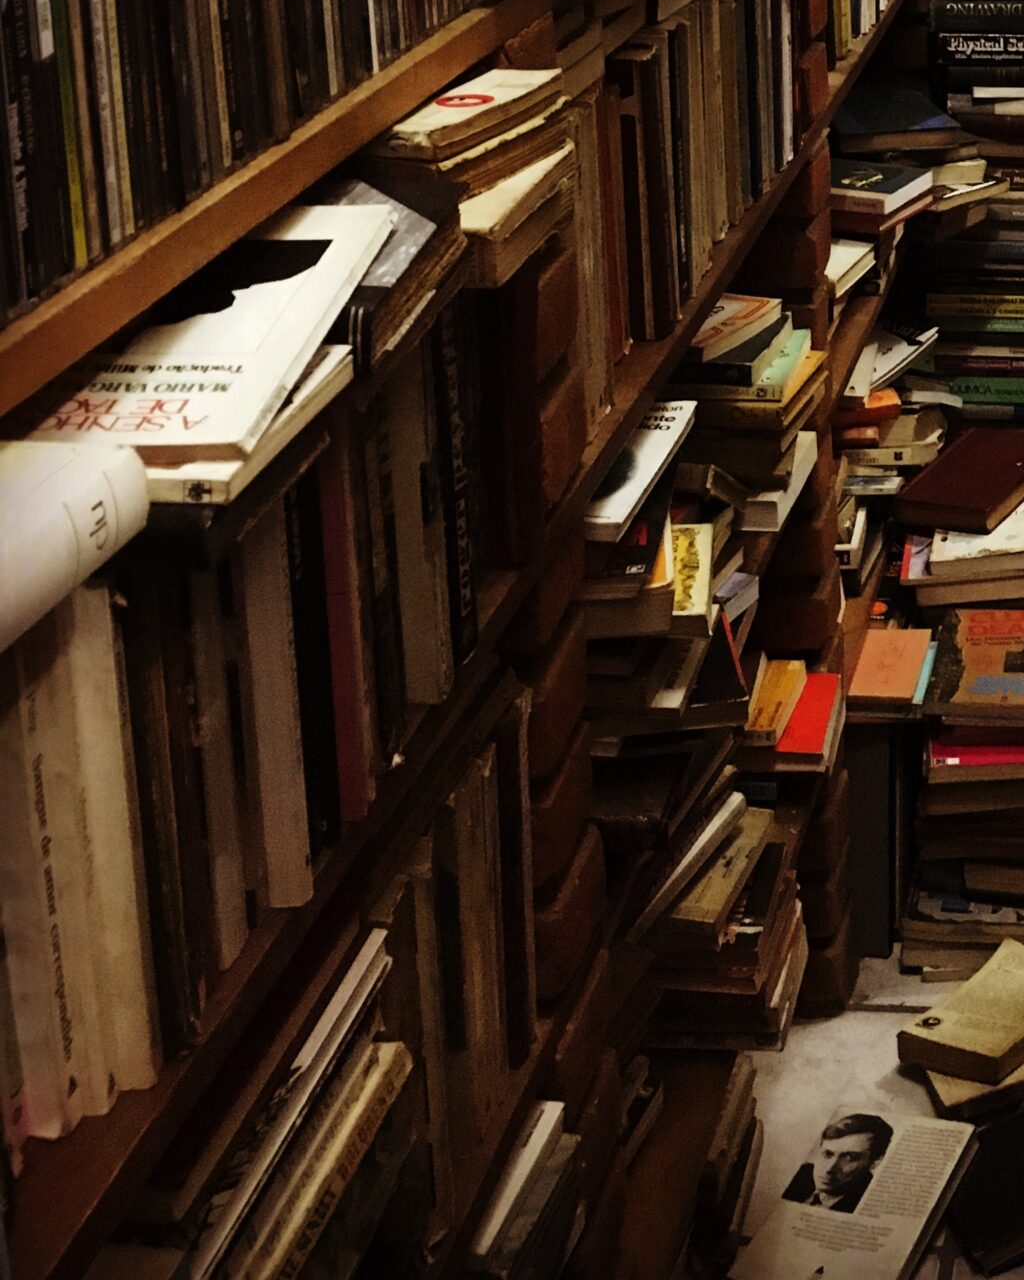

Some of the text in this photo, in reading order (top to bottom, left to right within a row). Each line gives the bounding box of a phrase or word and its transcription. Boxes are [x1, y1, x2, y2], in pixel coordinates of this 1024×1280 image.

[945, 2, 1023, 17] DRAWING
[84, 381, 148, 394] VARG
[57, 398, 118, 416] TAC
[36, 414, 172, 433] SENHO
